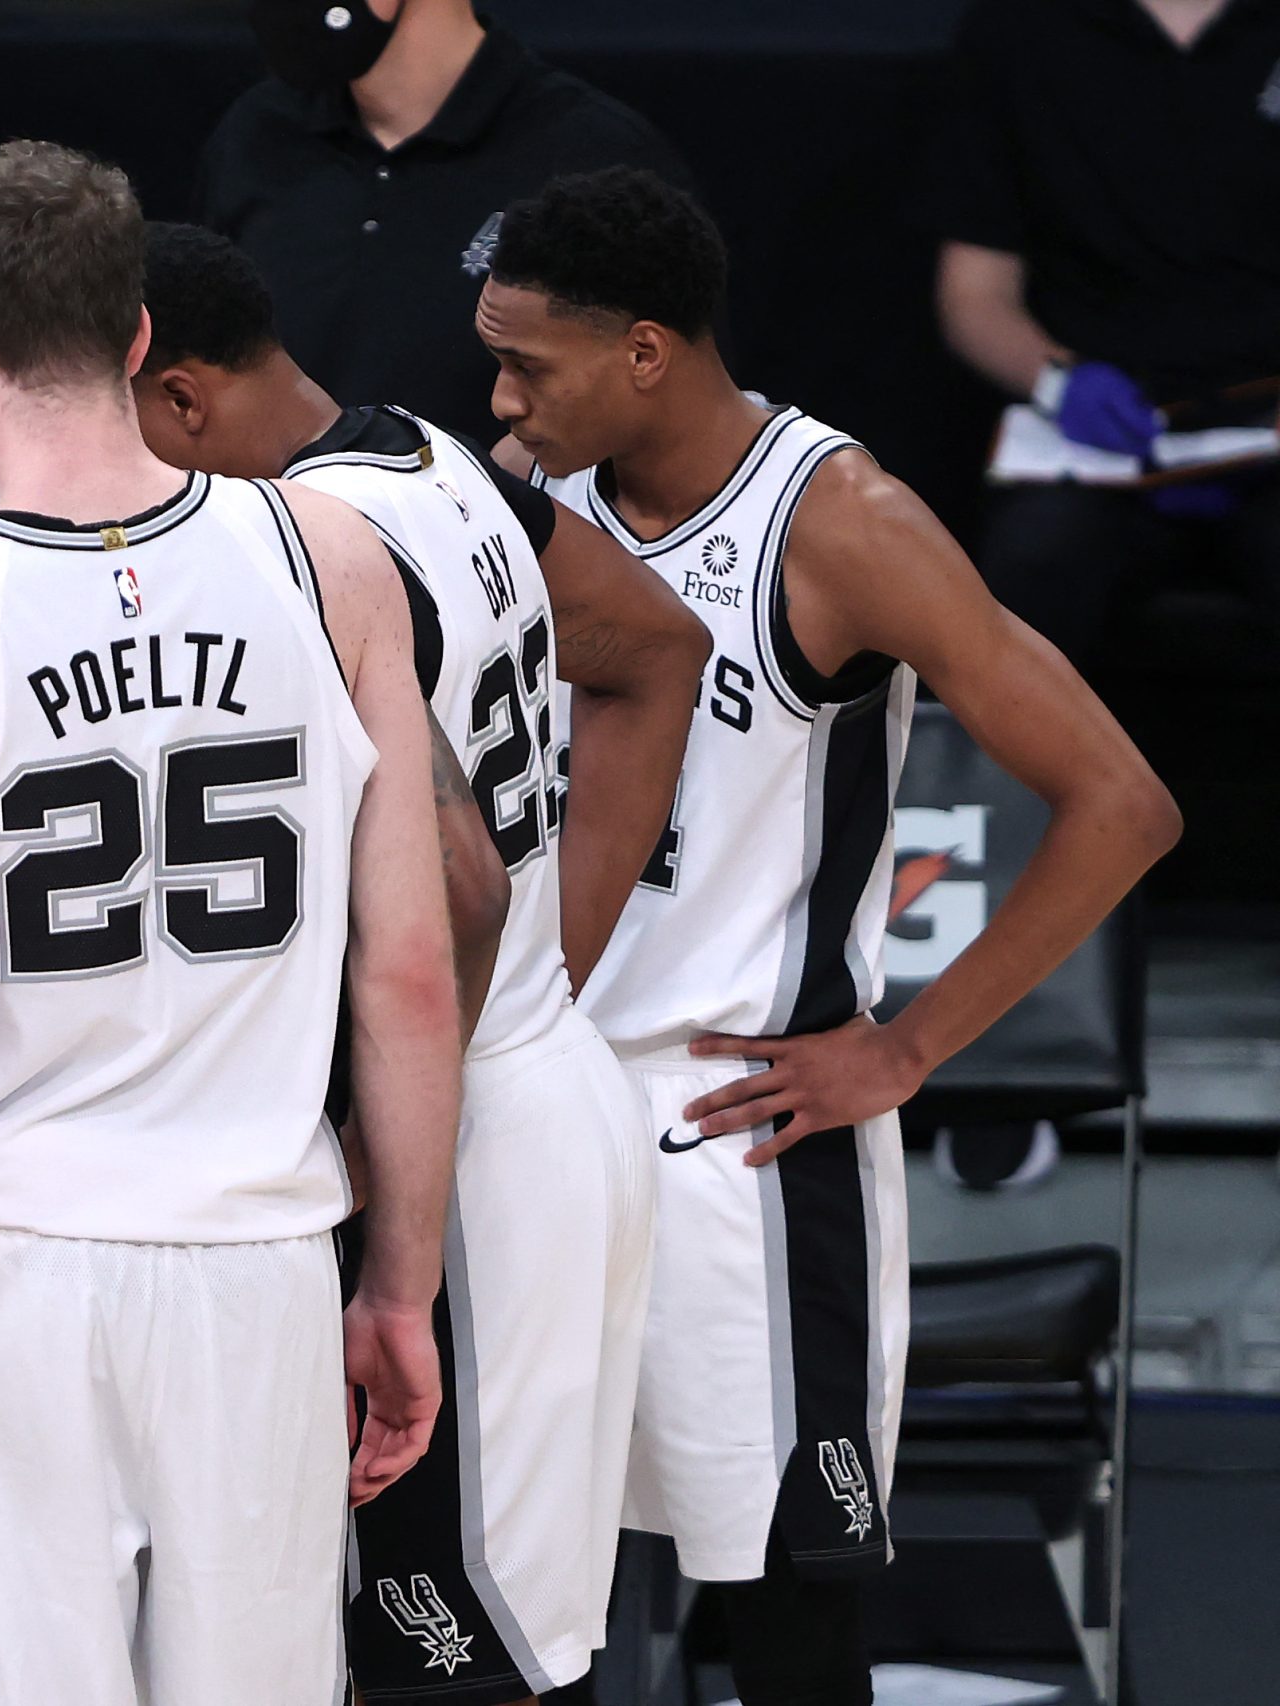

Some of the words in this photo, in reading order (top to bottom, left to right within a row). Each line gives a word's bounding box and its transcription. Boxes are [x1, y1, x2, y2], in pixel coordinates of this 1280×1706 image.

[472, 533, 518, 622] GAY
[681, 569, 744, 609] Frost
[26, 631, 248, 740] POELTL
